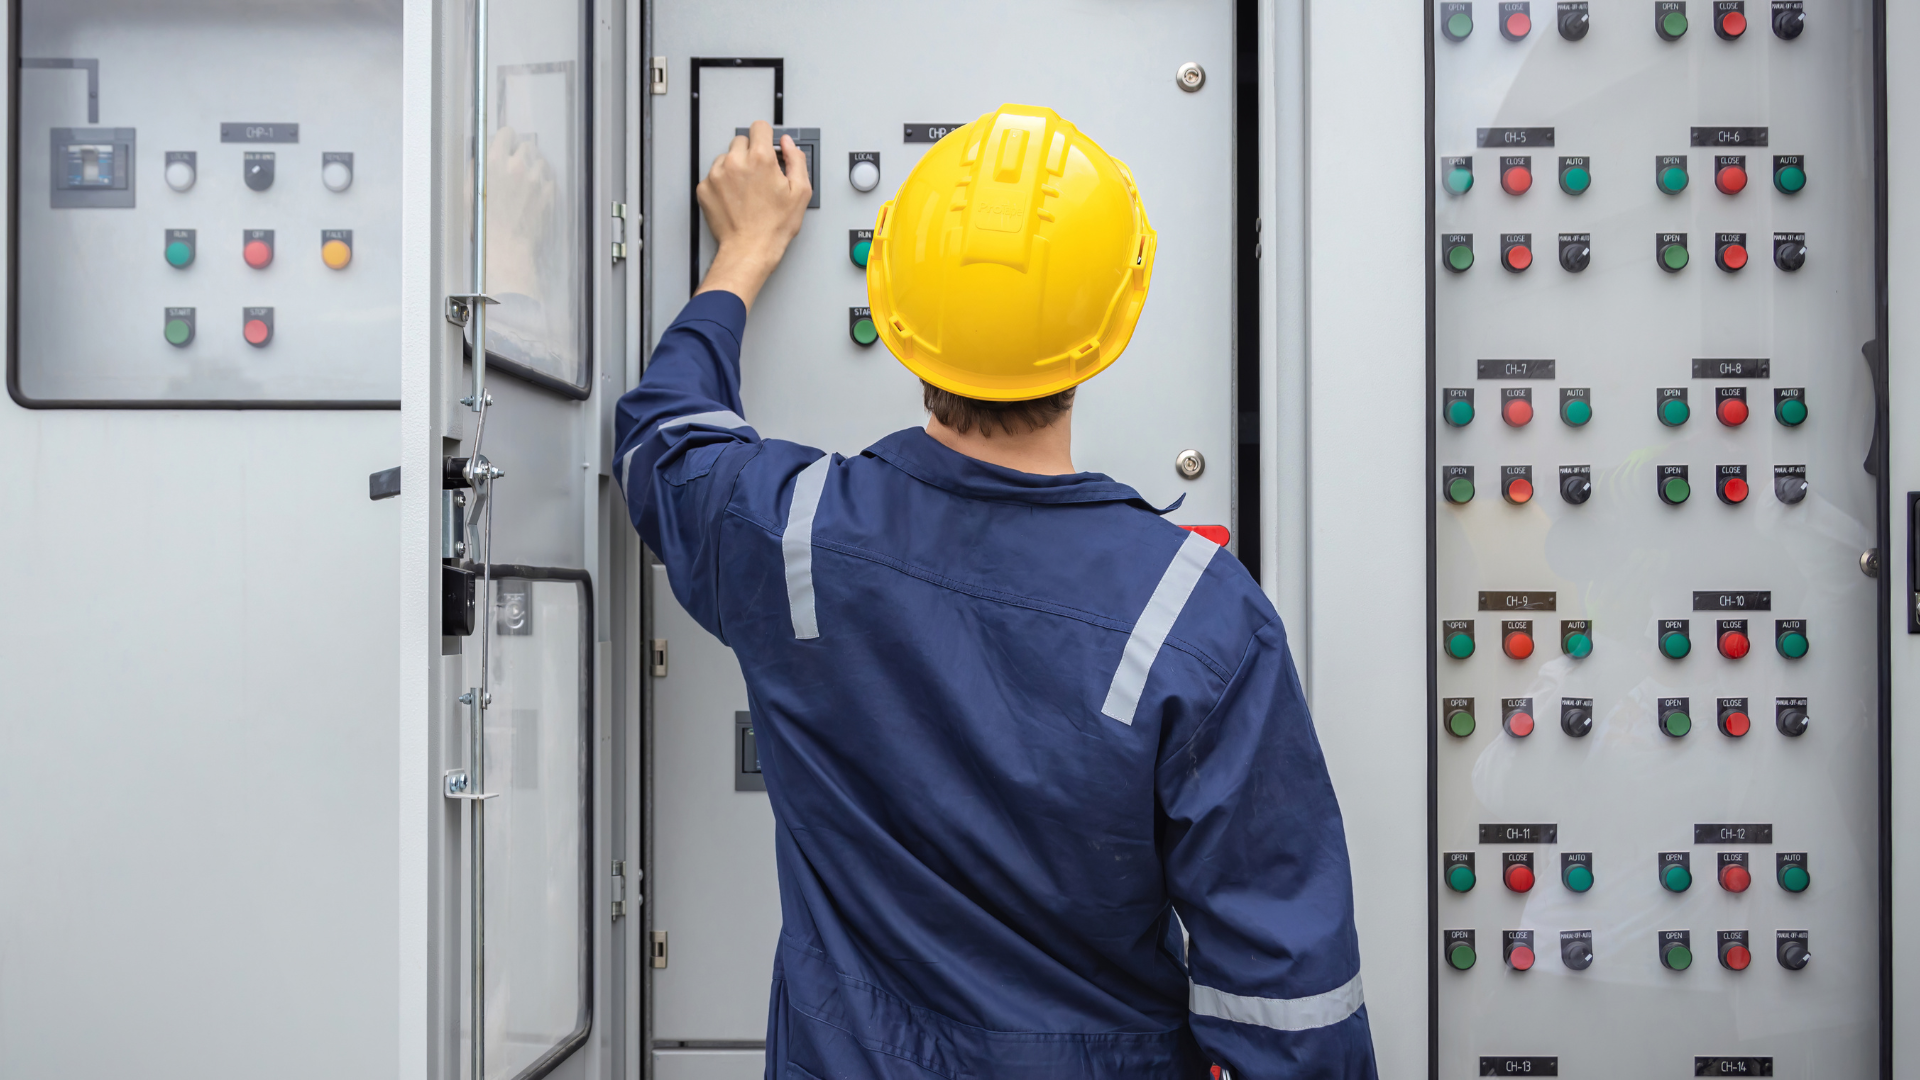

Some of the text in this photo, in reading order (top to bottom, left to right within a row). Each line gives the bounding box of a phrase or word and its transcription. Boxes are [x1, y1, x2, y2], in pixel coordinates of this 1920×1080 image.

[1448, 2, 1465, 10] OPEN
[1505, 2, 1523, 10] CLOSE
[1557, 2, 1588, 10] MANUAL-OFF-AUTO
[1662, 2, 1679, 10] OPEN
[1719, 2, 1738, 10] CLOSE
[1772, 2, 1802, 10] MANUAL-OFF-AUTO
[246, 127, 273, 138] CHP-1
[928, 127, 957, 139] CHP
[1718, 131, 1740, 142] CH-6
[1504, 132, 1527, 143] CH-5
[854, 153, 874, 161] LOCAL
[1449, 234, 1466, 242] OPEN
[1506, 234, 1525, 242] CLOSE
[1559, 234, 1590, 242] MANUAL-OFF-AUTO
[1664, 234, 1680, 242] OPEN
[1721, 234, 1740, 242] CLOSE
[1774, 234, 1804, 242] MANUAL-OFF-AUTO
[169, 308, 191, 316] START
[249, 308, 267, 316] STOP
[854, 308, 871, 316] STAR
[1505, 363, 1527, 375] CH-7
[1719, 363, 1742, 374] CH-8
[1450, 388, 1467, 396] OPEN
[1507, 388, 1525, 396] CLOSE
[1567, 388, 1584, 396] AUTO
[1664, 388, 1680, 396] OPEN
[1722, 388, 1740, 396] CLOSE
[1781, 388, 1798, 396] AUTO
[1506, 596, 1528, 607] CH-9
[1719, 595, 1745, 606] CH-10
[1450, 621, 1467, 629] OPEN
[1508, 621, 1526, 629] CLOSE
[1568, 621, 1585, 629] AUTO
[1665, 621, 1682, 629] OPEN
[1722, 621, 1741, 629] CLOSE
[1782, 621, 1800, 629] AUTO
[1450, 699, 1467, 707] OPEN
[1508, 699, 1526, 707] CLOSE
[1665, 699, 1682, 707] OPEN
[1723, 699, 1742, 707] CLOSE
[1506, 828, 1530, 840] CH-11
[1720, 828, 1745, 840] CH-12
[1451, 854, 1468, 862] OPEN
[1508, 854, 1527, 862] CLOSE
[1568, 854, 1585, 862] AUTO
[1666, 854, 1682, 862] OPEN
[1723, 854, 1742, 862] CLOSE
[1784, 854, 1801, 862] AUTO
[1452, 931, 1468, 939] OPEN
[1509, 931, 1527, 939] CLOSE
[1560, 931, 1592, 939] MANUAL-OFF-AUTO
[1666, 931, 1682, 939] OPEN
[1723, 931, 1742, 939] CLOSE
[1777, 931, 1808, 939] MANUAL-OFF-AUTO
[1506, 1061, 1531, 1072] CH-13
[1721, 1061, 1747, 1072] CH-14
